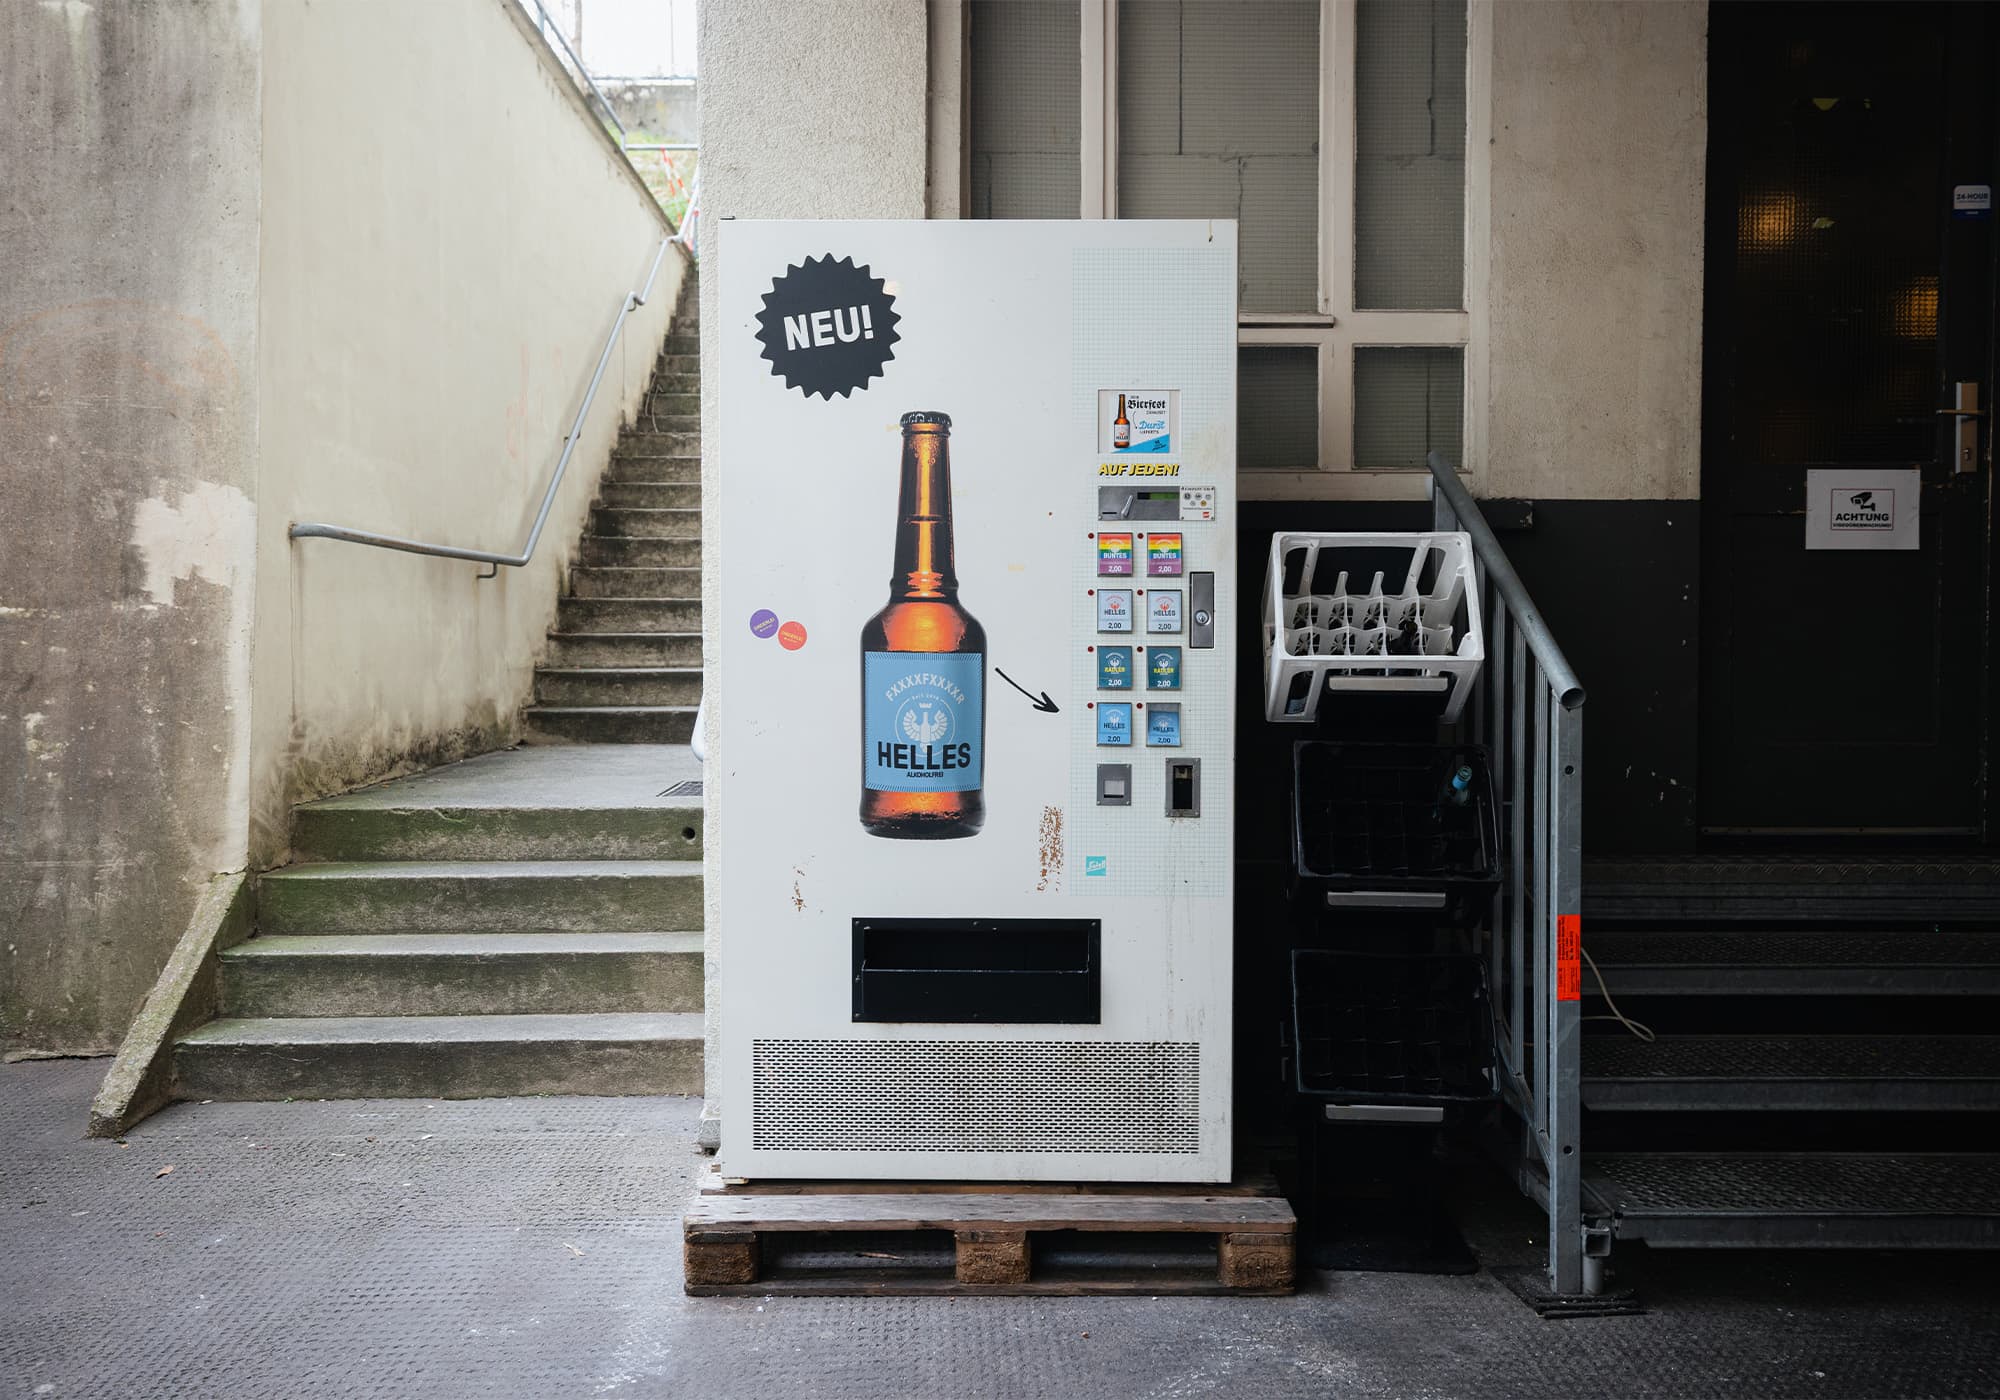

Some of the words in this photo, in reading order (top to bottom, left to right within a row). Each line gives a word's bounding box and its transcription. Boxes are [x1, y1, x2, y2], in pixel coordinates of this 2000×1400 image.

[783, 304, 874, 351] NEU!
[1127, 399, 1166, 410] Bierfest
[1098, 463, 1128, 476] AUF
[1128, 463, 1180, 476] JEDEN!
[1835, 513, 1889, 521] ACHTUNG
[1108, 565, 1122, 573] 2,00
[885, 672, 966, 705] FXXXXFXXXXR
[1107, 735, 1121, 743] 2,00
[877, 740, 972, 770] HELLES
